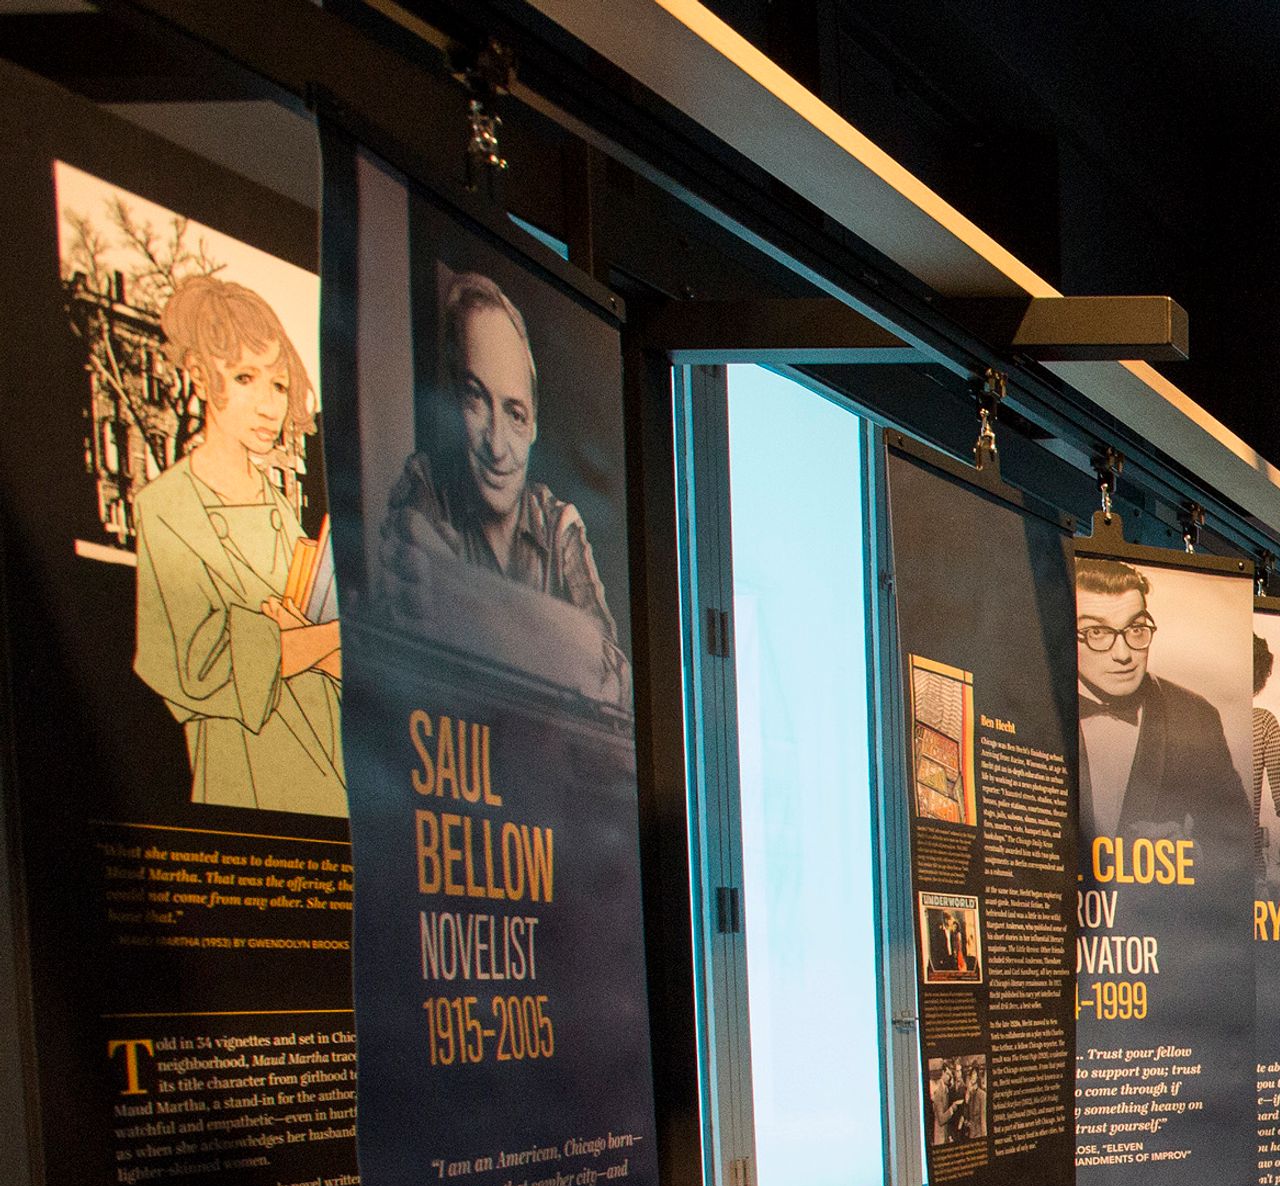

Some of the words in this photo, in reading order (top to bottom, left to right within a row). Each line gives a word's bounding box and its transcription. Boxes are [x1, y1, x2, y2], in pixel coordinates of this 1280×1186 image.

[410, 709, 503, 807] SAUL
[145, 847, 168, 860] she
[171, 849, 218, 864] wanted
[222, 854, 247, 866] was
[250, 855, 262, 867] to
[265, 855, 303, 869] donate
[416, 808, 554, 903] BELLOW
[1092, 836, 1195, 885] CLOSE
[148, 868, 202, 884] Martha.
[206, 870, 235, 886] That
[239, 875, 263, 887] was
[266, 876, 284, 889] the
[923, 894, 975, 908] UNDERWORLD
[248, 938, 310, 950] GWENDOLYN
[312, 939, 350, 951] BROOKS
[420, 911, 539, 980] NOVELIST
[423, 995, 555, 1066] 1915-2005
[214, 1032, 270, 1055] vignettes
[272, 1033, 297, 1047] and
[1088, 1047, 1122, 1060] Trust
[1124, 1048, 1153, 1062] your
[1155, 1045, 1192, 1061] fellow
[158, 1055, 249, 1075] neighborhood,
[252, 1053, 287, 1068] Maud
[288, 1051, 330, 1066] Martha
[1091, 1065, 1139, 1080] support
[1142, 1066, 1168, 1079] you;
[1171, 1063, 1202, 1076] trust
[178, 1076, 204, 1093] title
[207, 1072, 267, 1090] character
[269, 1071, 299, 1085] from
[301, 1068, 347, 1087] girlhood
[1085, 1087, 1117, 1098] come
[1120, 1082, 1167, 1098] through
[1169, 1081, 1182, 1097] if
[1084, 1102, 1148, 1116] something
[1150, 1100, 1186, 1114] heavy
[1188, 1099, 1203, 1110] on
[1076, 1122, 1106, 1134] trust
[448, 1160, 471, 1177] am
[475, 1156, 493, 1173] an
[496, 1145, 562, 1169] American,
[564, 1137, 606, 1157] Chicago
